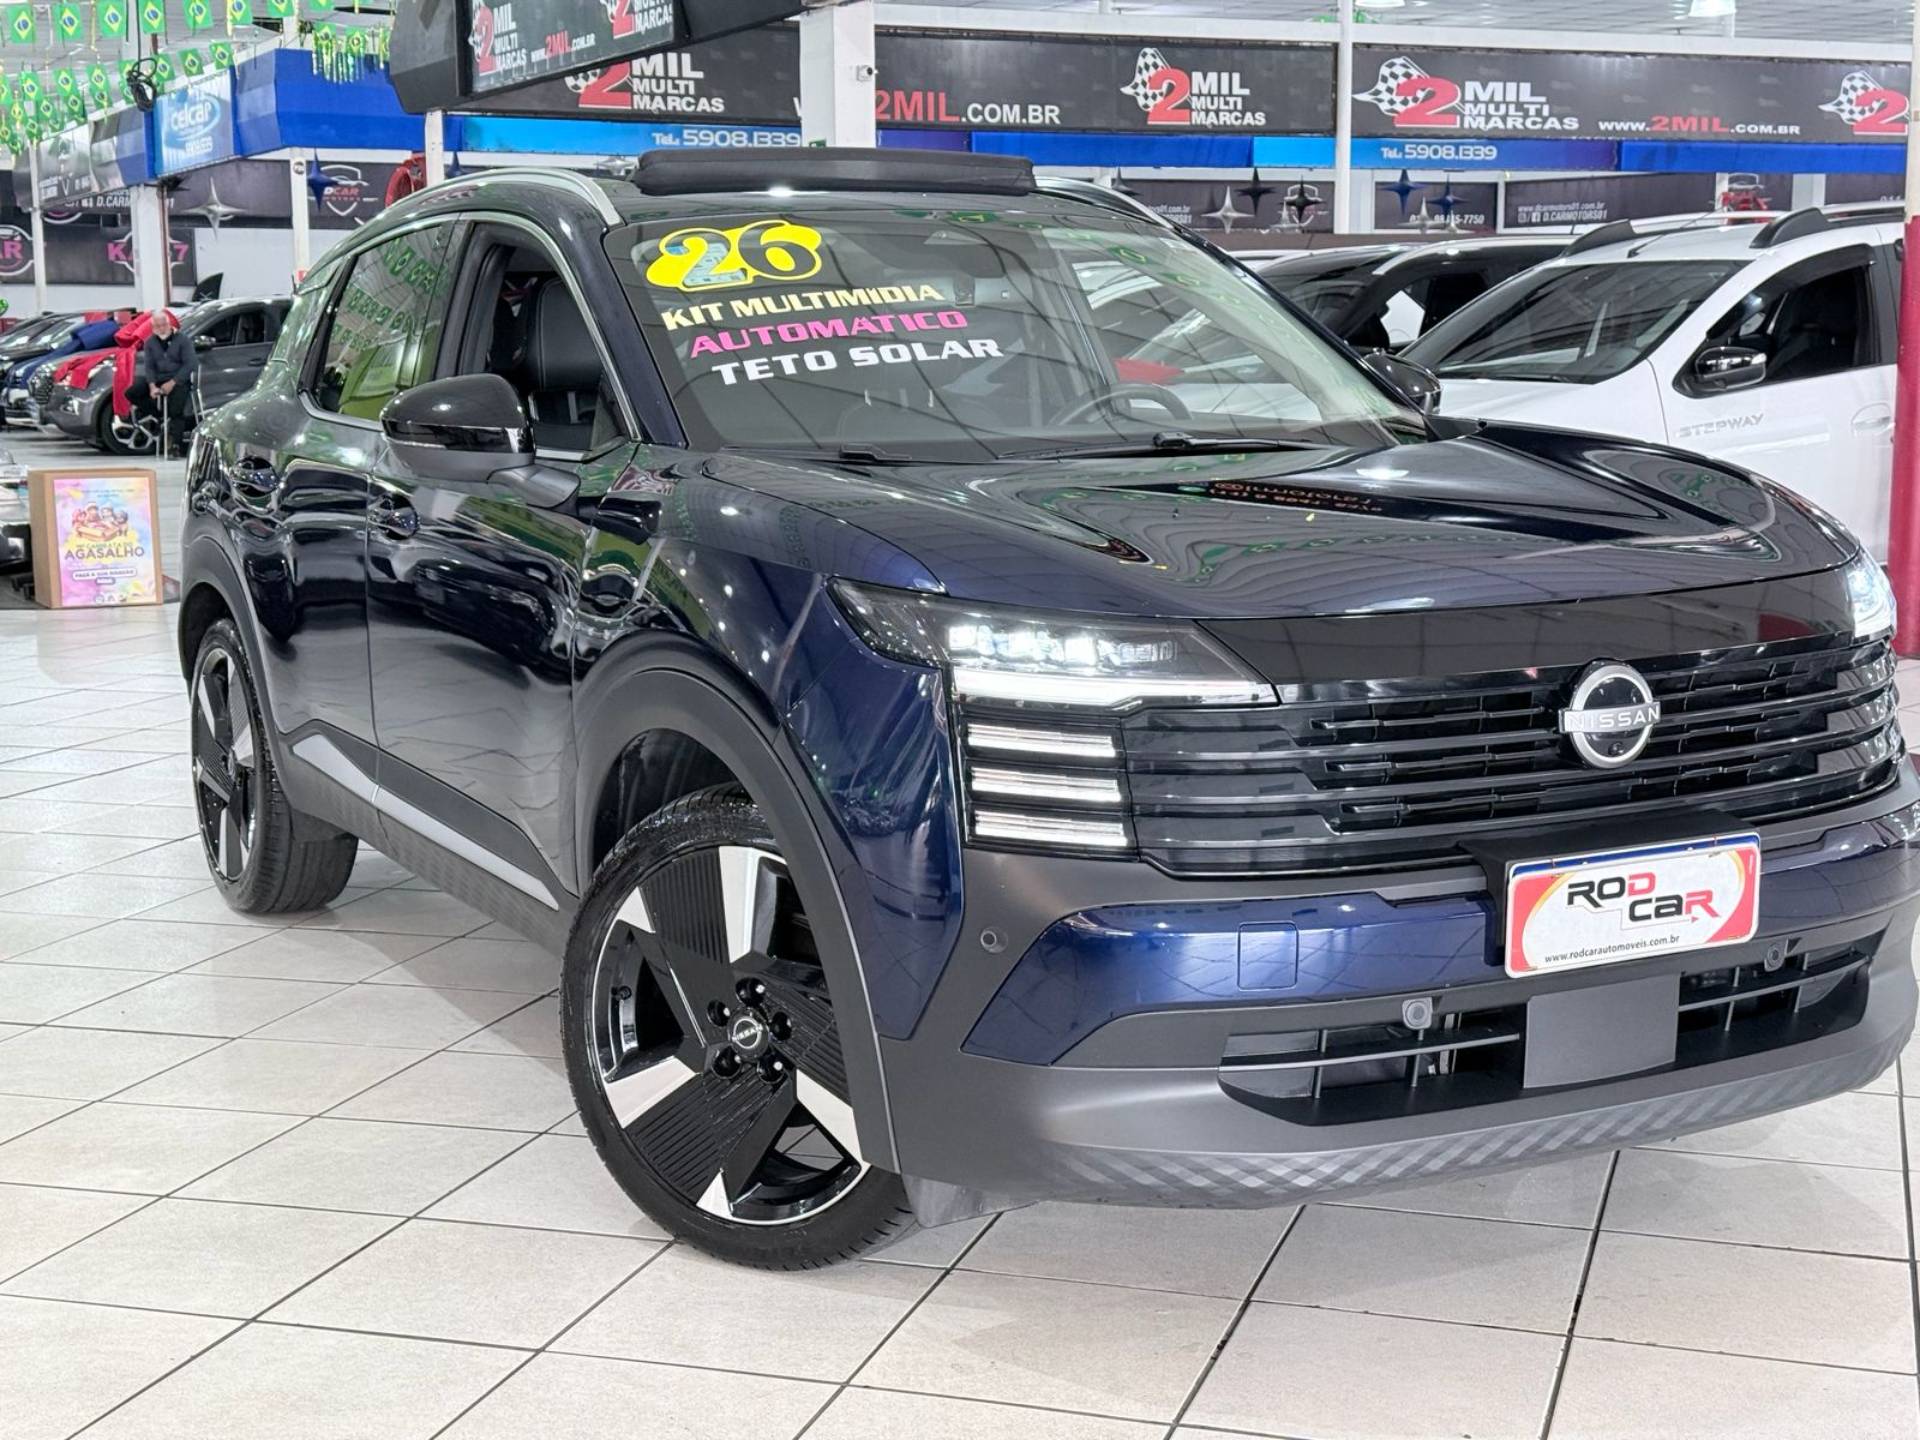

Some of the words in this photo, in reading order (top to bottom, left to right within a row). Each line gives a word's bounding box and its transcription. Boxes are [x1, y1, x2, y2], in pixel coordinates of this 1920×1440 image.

[493, 2, 517, 34] MIL
[493, 32, 518, 54] MULTI
[495, 47, 527, 71] MARCAS
[631, 52, 704, 79] MIL
[632, 77, 696, 95] MULTI
[1147, 66, 1191, 125] 2
[1191, 71, 1250, 95] MIL
[633, 94, 725, 113] MARCAS
[1191, 95, 1242, 111] MULTI
[1393, 77, 1461, 128] 2
[1463, 80, 1547, 103] MIL
[1463, 102, 1550, 117] MULTI
[1853, 88, 1910, 136] 2
[1191, 110, 1267, 127] MARCAS
[1463, 115, 1580, 130] MARCAS
[682, 128, 801, 148] 5908.1339
[1404, 144, 1498, 161] 5908.1339
[646, 219, 822, 292] 26
[661, 302, 724, 331] KIT
[711, 350, 838, 386] TETO
[848, 338, 1004, 368] SOLAR
[1678, 413, 1765, 438] STEPWAY
[65, 546, 145, 560] AGASALHO
[1567, 705, 1660, 730] NISSAN
[1566, 872, 1656, 908] ROD
[1544, 933, 1681, 964] www.rodcarautomoveis.com.br
